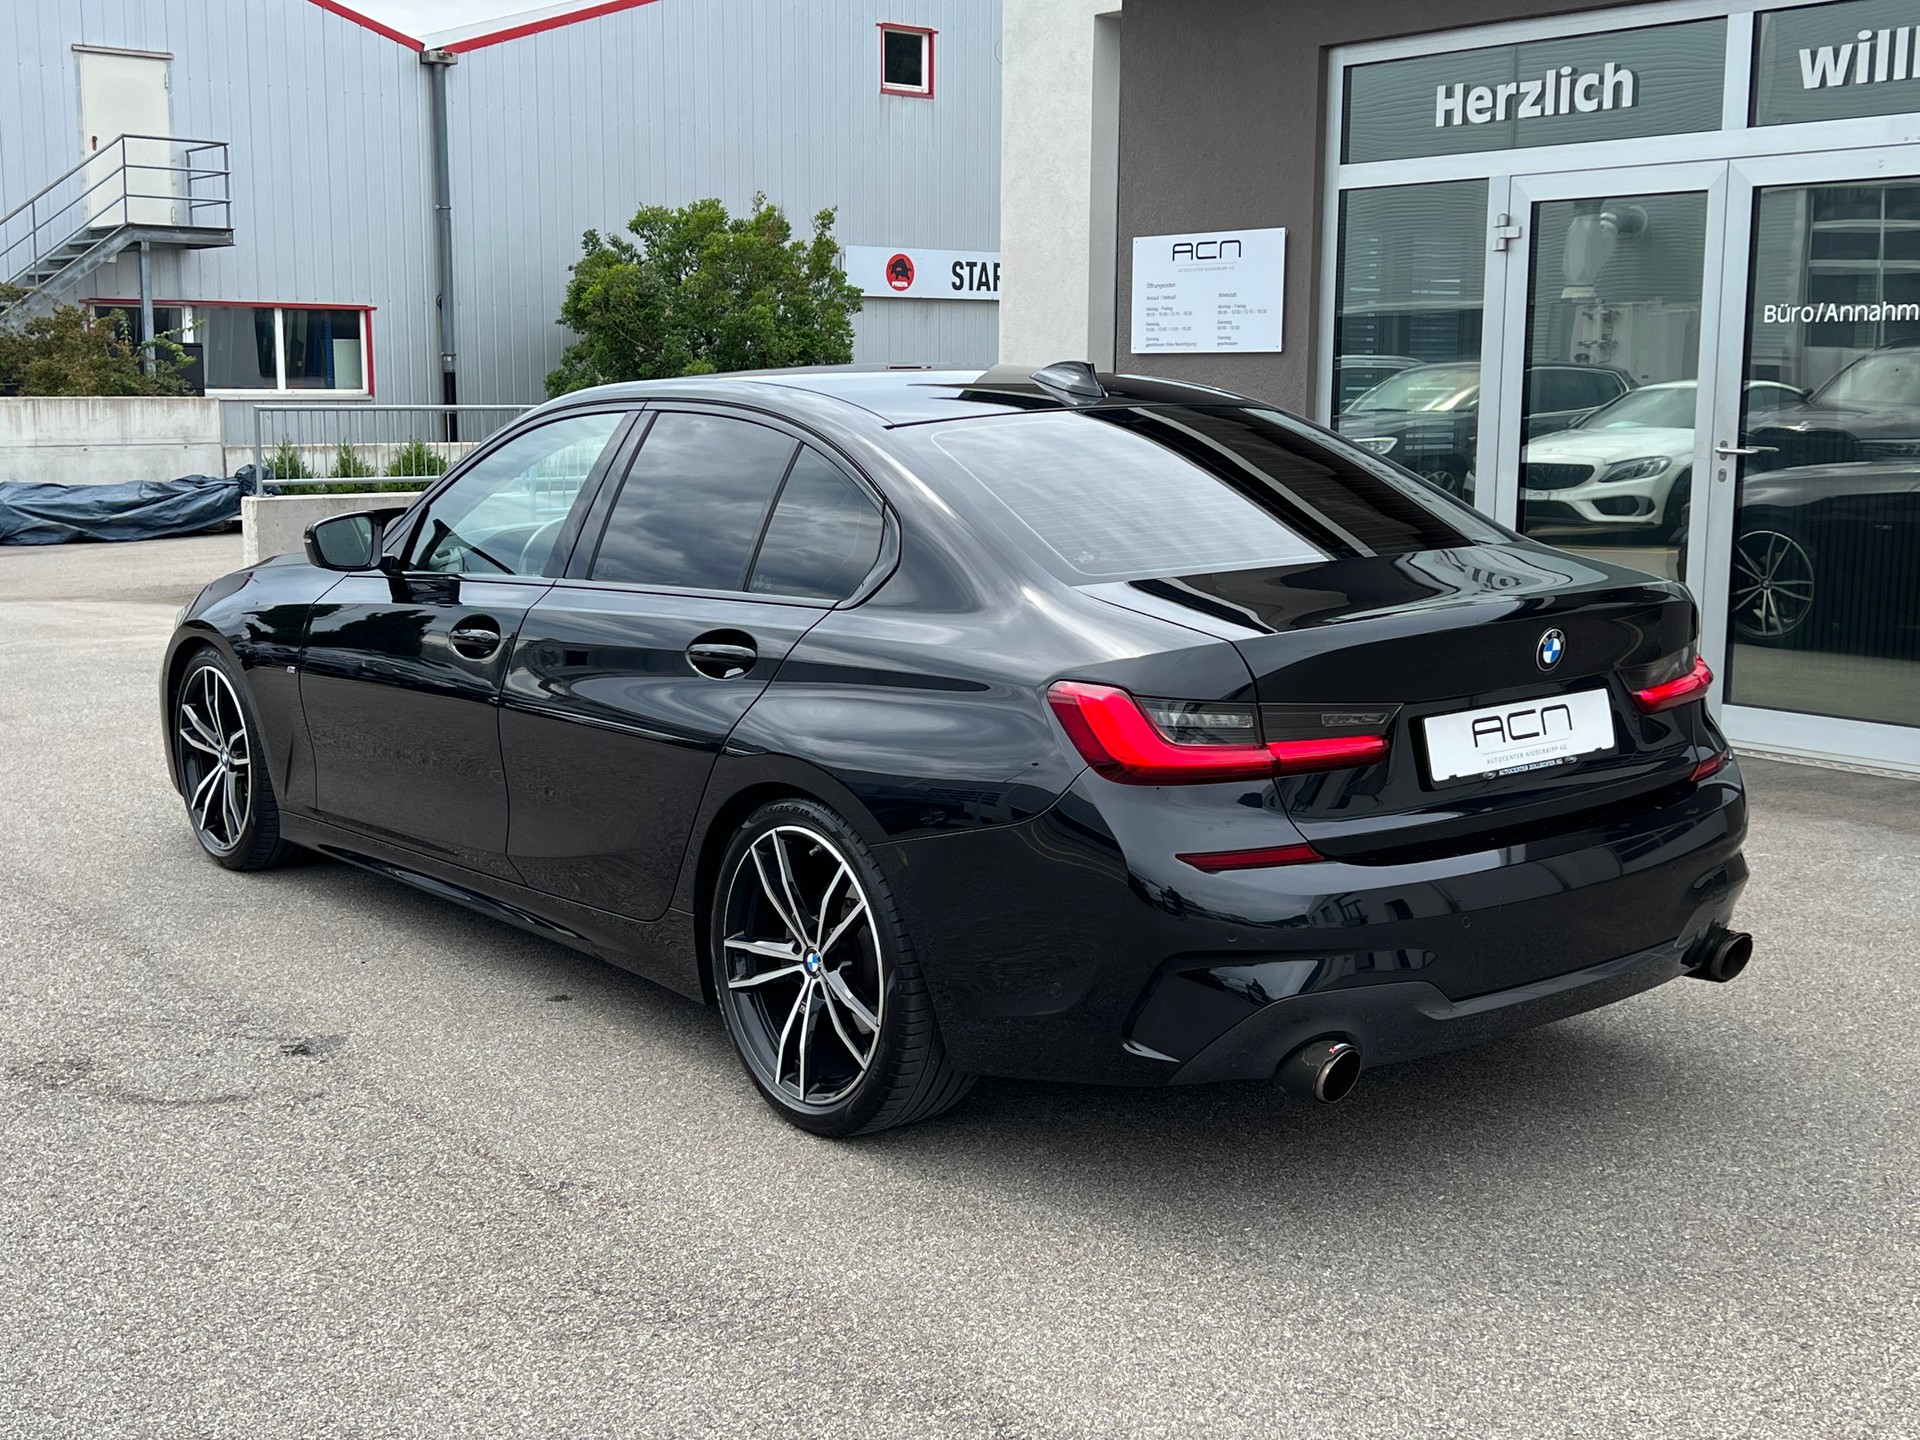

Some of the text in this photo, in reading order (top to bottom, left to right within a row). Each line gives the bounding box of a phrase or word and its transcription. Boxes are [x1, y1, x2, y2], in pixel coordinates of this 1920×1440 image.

[1435, 25, 1920, 128] Herzlich will
[1172, 239, 1242, 262] ACN
[1471, 703, 1573, 748] ACN
[1486, 752, 1524, 765] AUTOCENTER
[1559, 743, 1568, 751] AG
